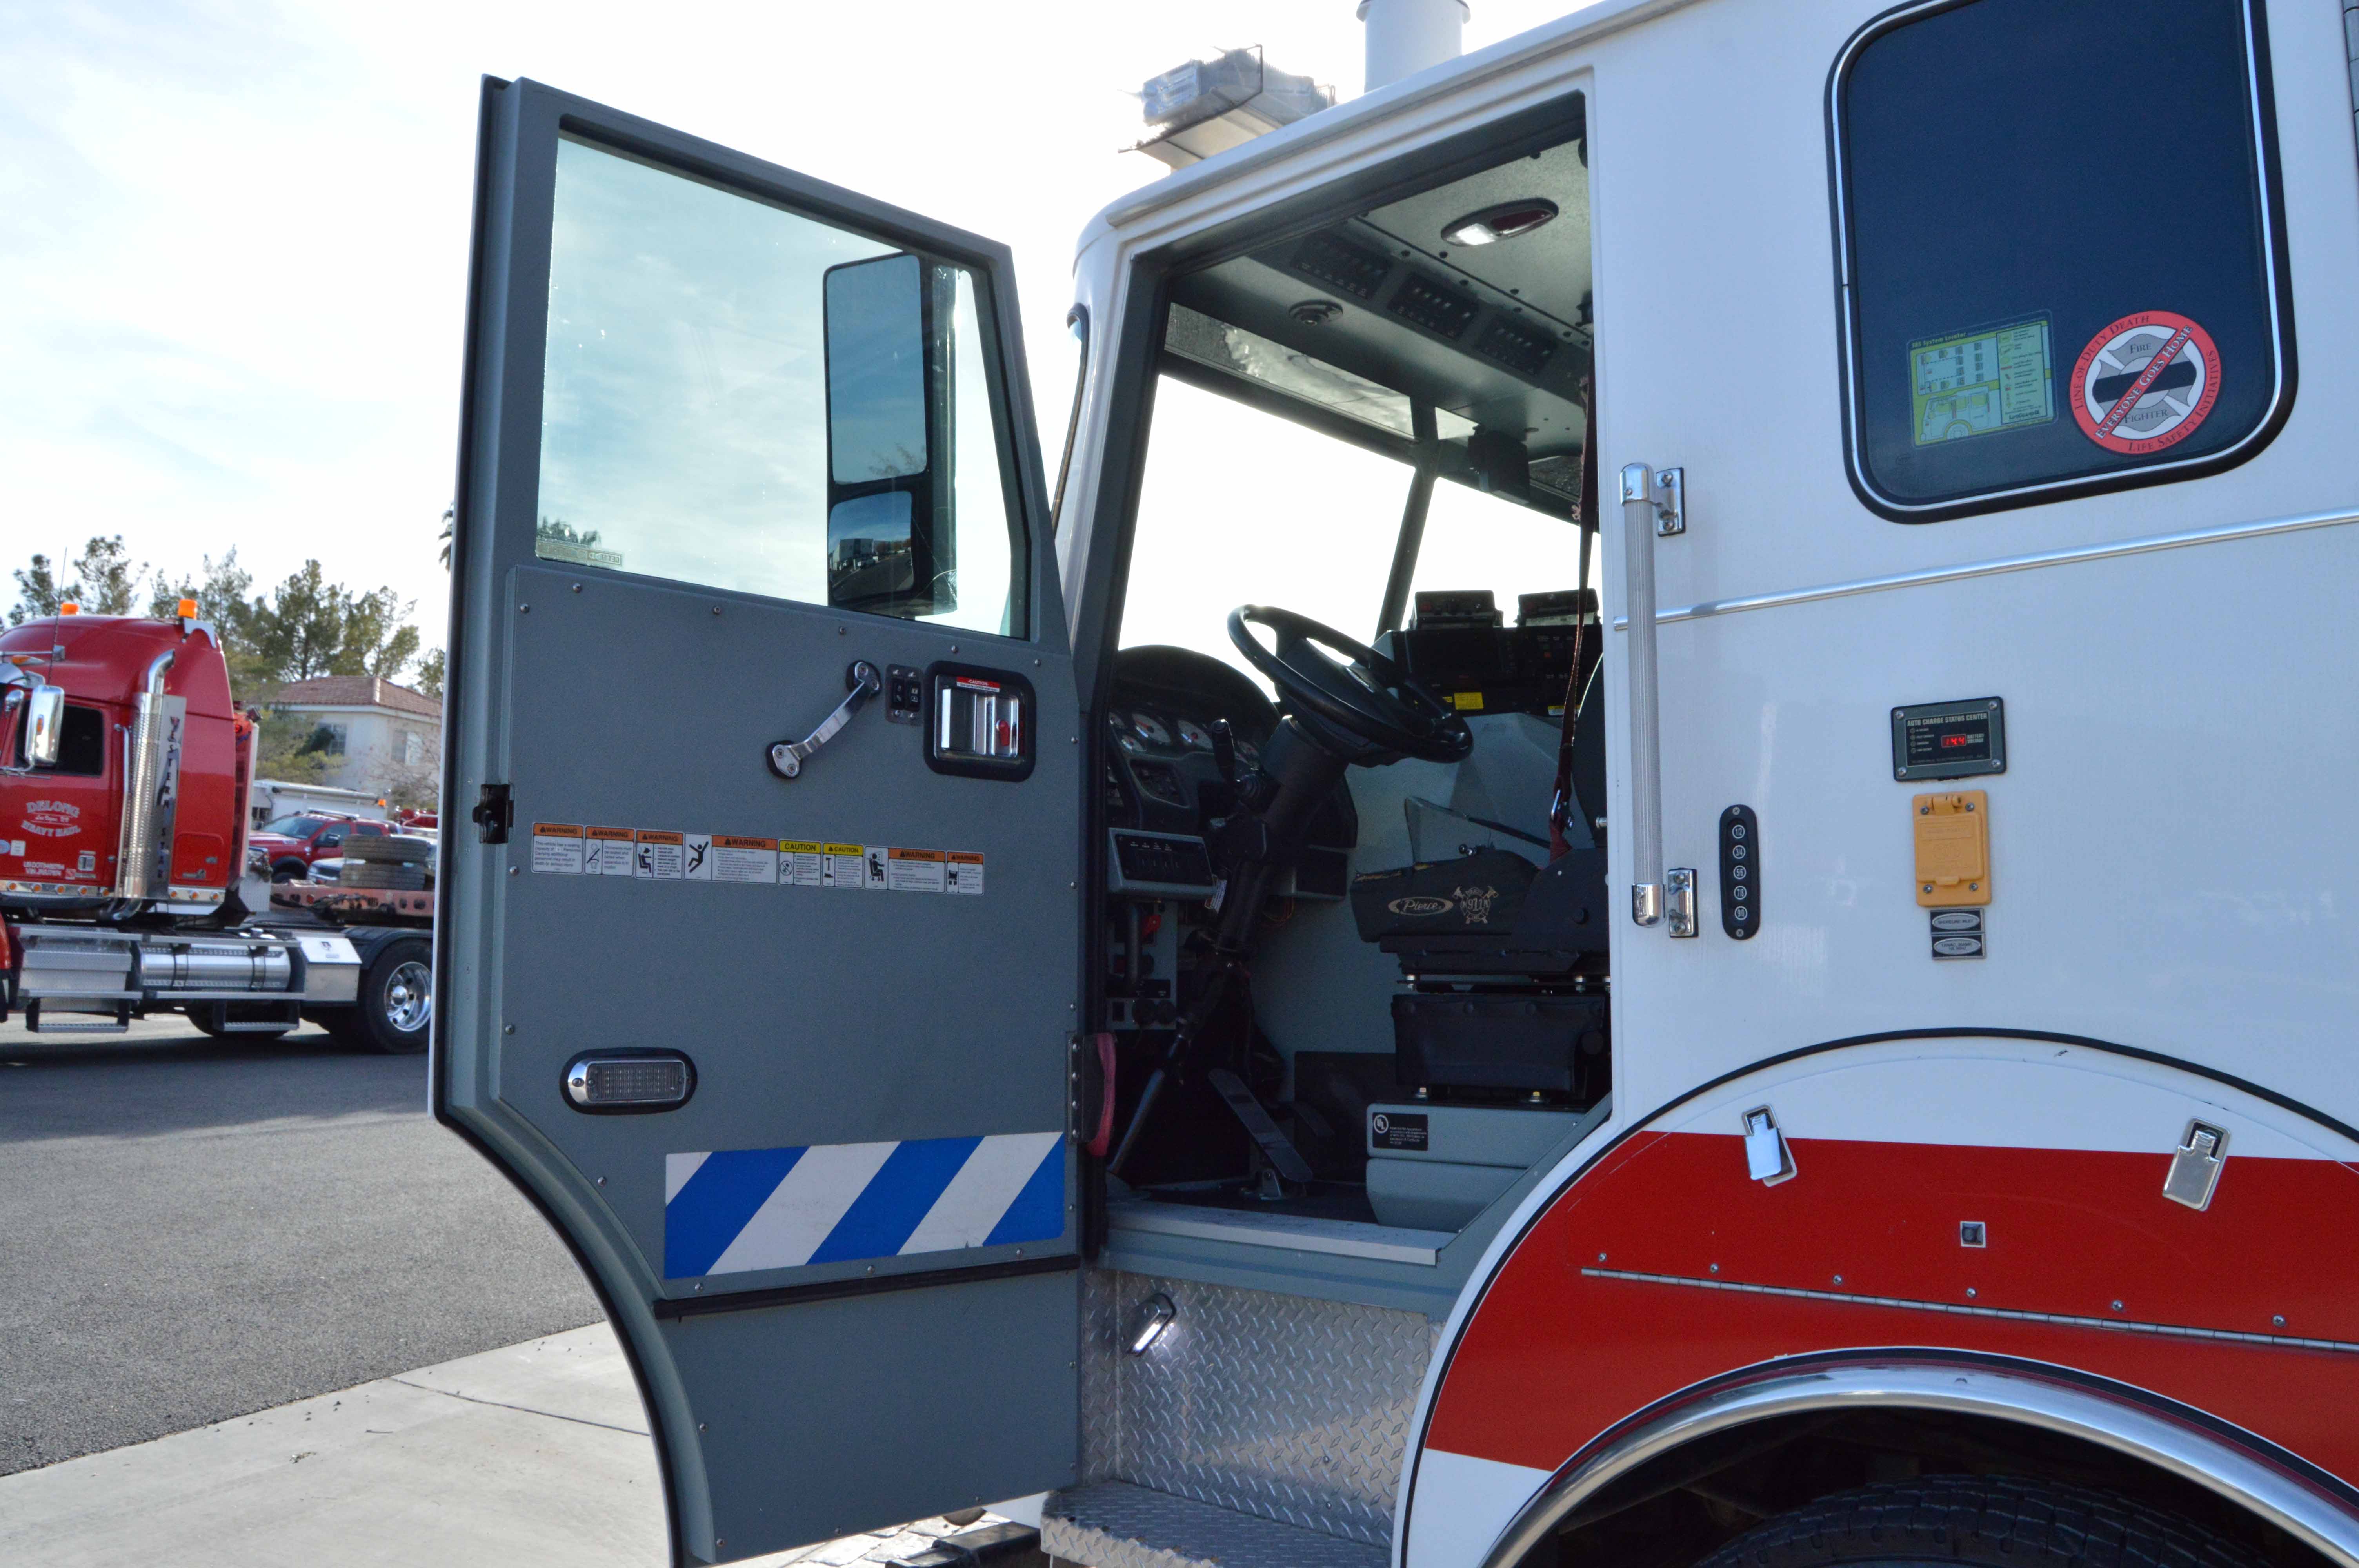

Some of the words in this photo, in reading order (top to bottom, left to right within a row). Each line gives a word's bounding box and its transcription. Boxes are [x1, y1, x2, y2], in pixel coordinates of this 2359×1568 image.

[2109, 315, 2149, 335] DEATH
[1923, 337, 1944, 346] System
[2130, 343, 2152, 354] FIRE
[2095, 387, 2142, 440] EVERYONE
[2139, 359, 2165, 387] GOES
[2161, 325, 2193, 358] HOME
[2128, 441, 2155, 452] LIFE
[2157, 419, 2197, 448] SAFETY
[2195, 350, 2219, 418] INITIATIVES
[2123, 410, 2168, 423] FIGHTER
[26, 800, 80, 818] DELONG
[732, 838, 766, 847] WARNING
[785, 843, 816, 851] CAUTION
[905, 851, 935, 859] WARNING
[1402, 900, 1438, 912] Pierce
